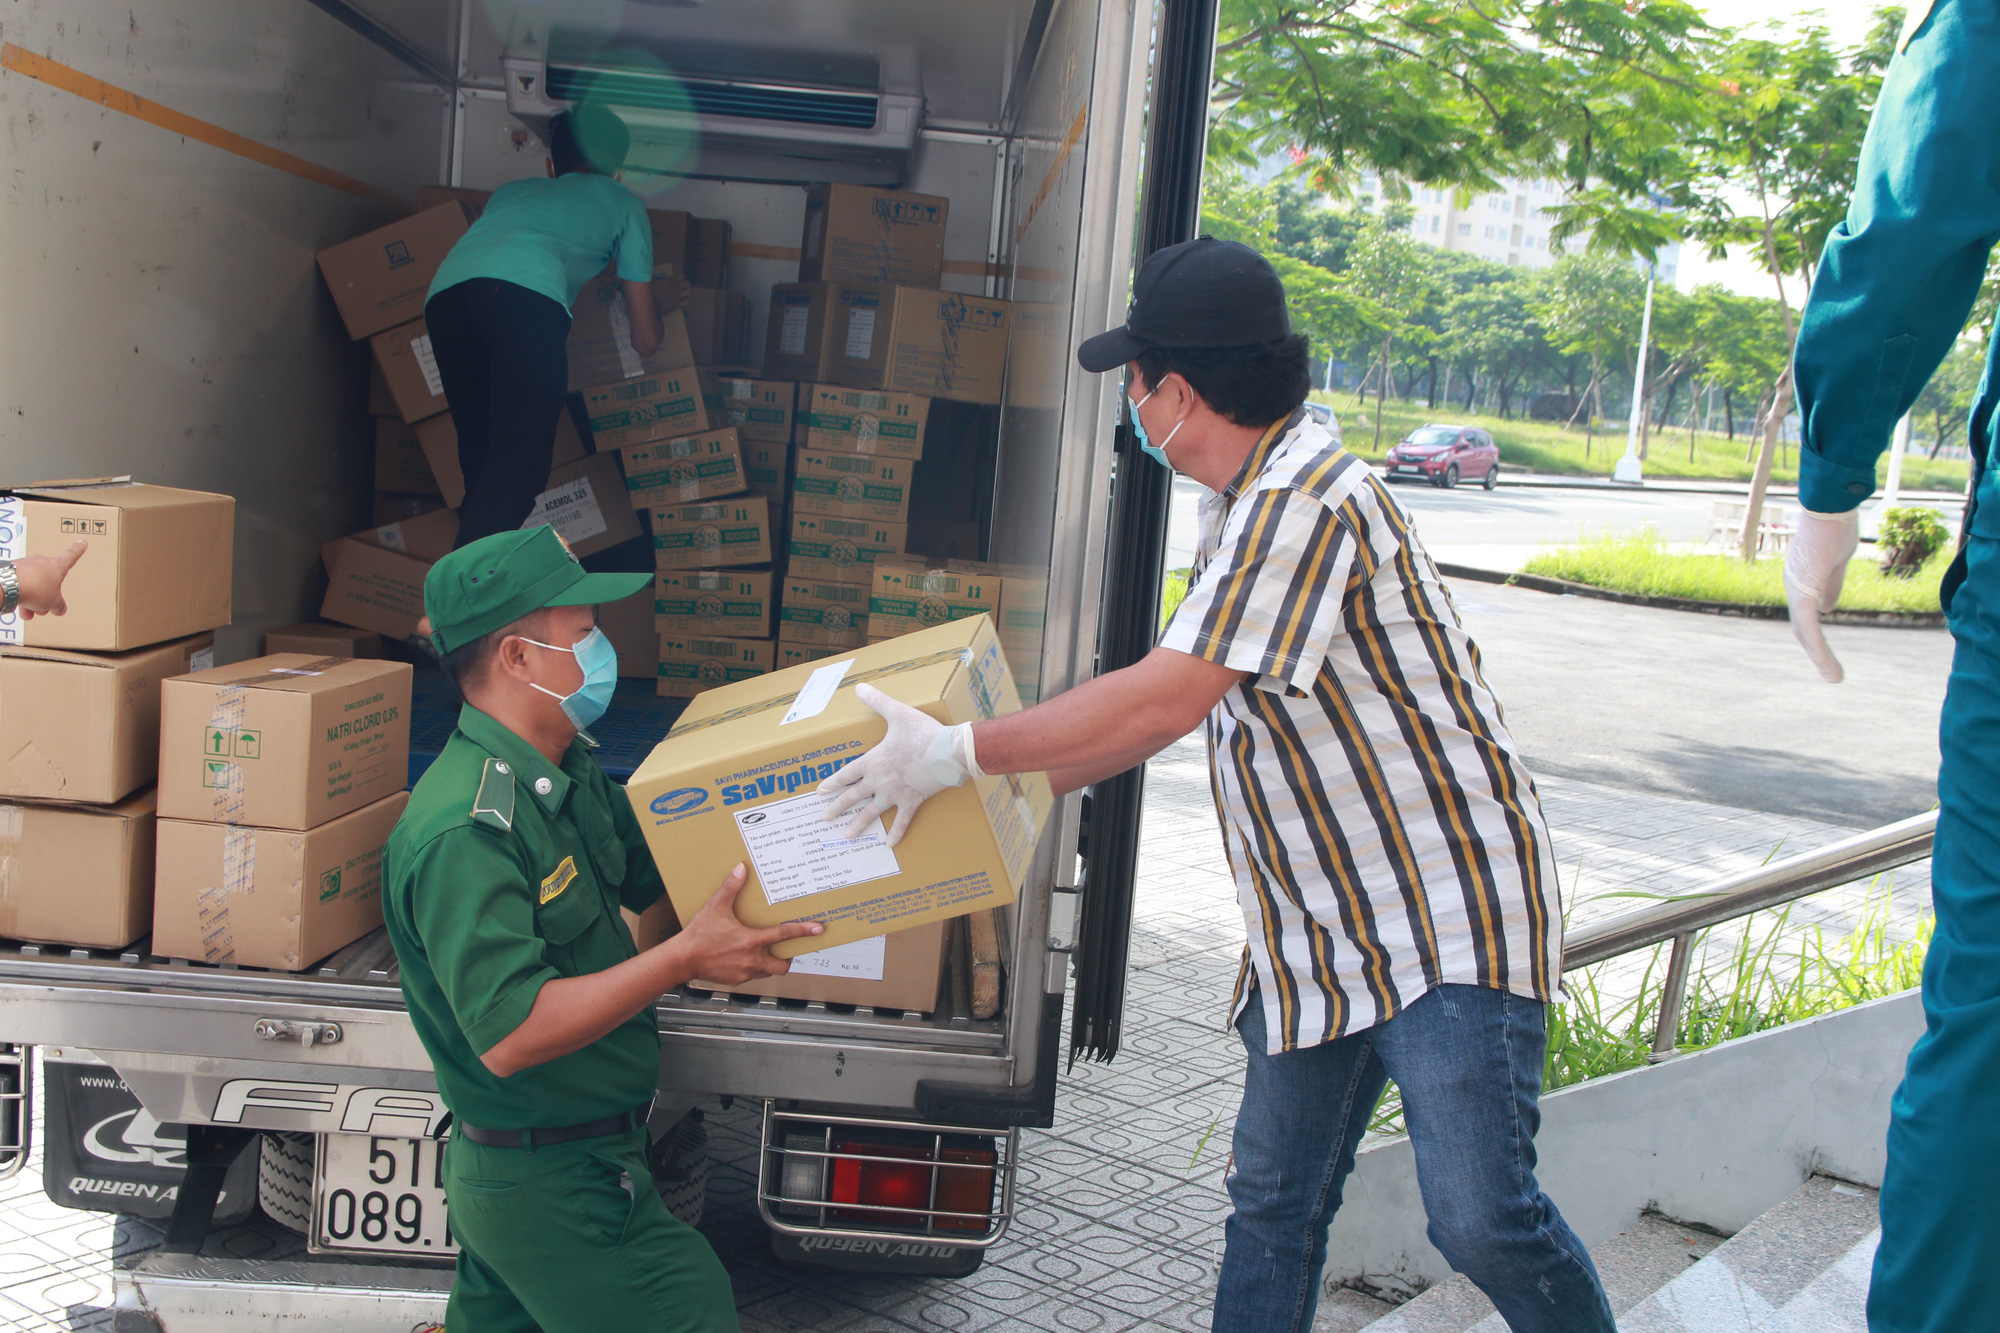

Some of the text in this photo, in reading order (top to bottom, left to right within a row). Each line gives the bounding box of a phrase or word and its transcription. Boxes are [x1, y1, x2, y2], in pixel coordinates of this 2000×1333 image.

[545, 493, 574, 511] ACEMOL
[575, 489, 587, 500] 325
[550, 510, 582, 528] 010119B
[882, 606, 907, 615] BRAND
[327, 707, 398, 742] NATRI CLORID 0,9%
[715, 740, 863, 785] SAVI PHARMACEUTICAL JOINT-STOCK Co.
[798, 830, 812, 838] Thùng
[810, 864, 829, 872] 20/04/21
[816, 883, 832, 891] Phùng
[970, 878, 989, 886] Vietnam
[801, 912, 827, 922] BUILDING,
[828, 904, 859, 915] FACTORIES,
[860, 897, 886, 907] GENERAL
[887, 888, 921, 900] WAREHOUSE
[925, 878, 963, 891] DISTRIBUTION
[964, 871, 987, 881] CENTER
[80, 1075, 130, 1093] www.q
[211, 1078, 452, 1139] FA
[327, 1188, 452, 1247] 089.1
